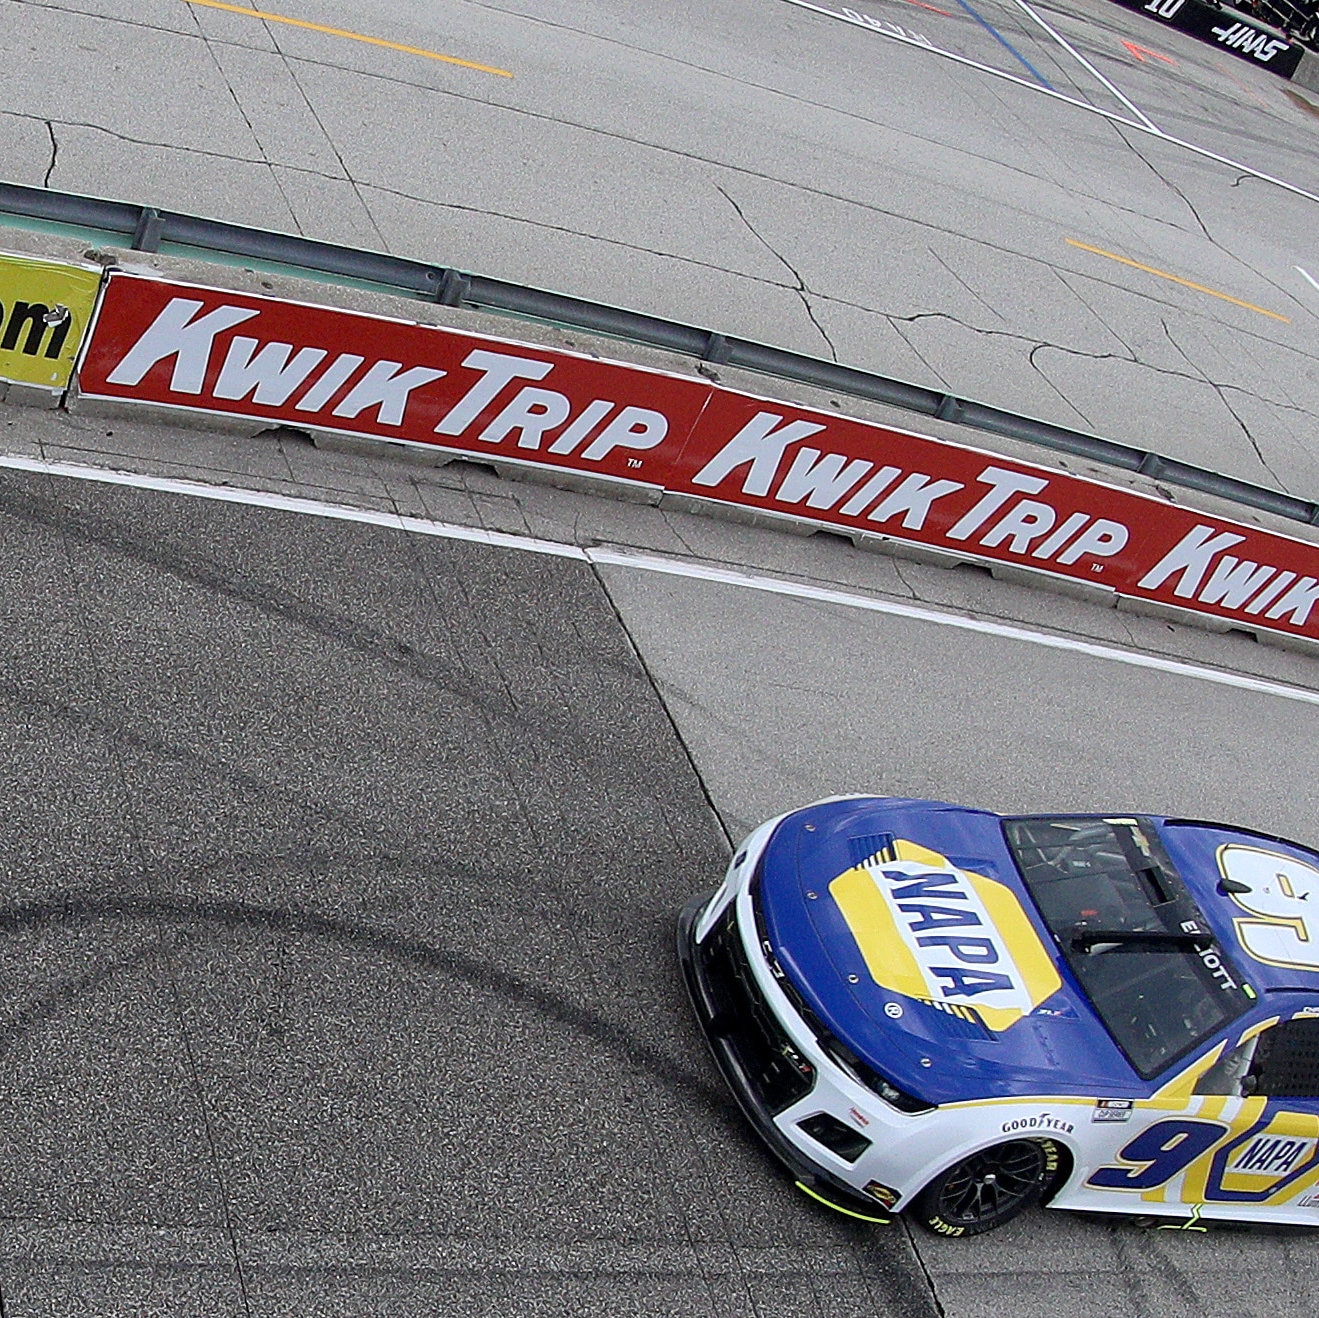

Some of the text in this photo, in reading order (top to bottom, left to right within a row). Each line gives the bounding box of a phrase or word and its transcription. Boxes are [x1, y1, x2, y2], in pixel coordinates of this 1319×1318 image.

[1211, 23, 1289, 62] HAAS
[882, 870, 1016, 998] NAPA
[1084, 1115, 1231, 1192] 9
[1234, 1136, 1308, 1173] NAPA
[928, 1215, 965, 1238] EAGLE
